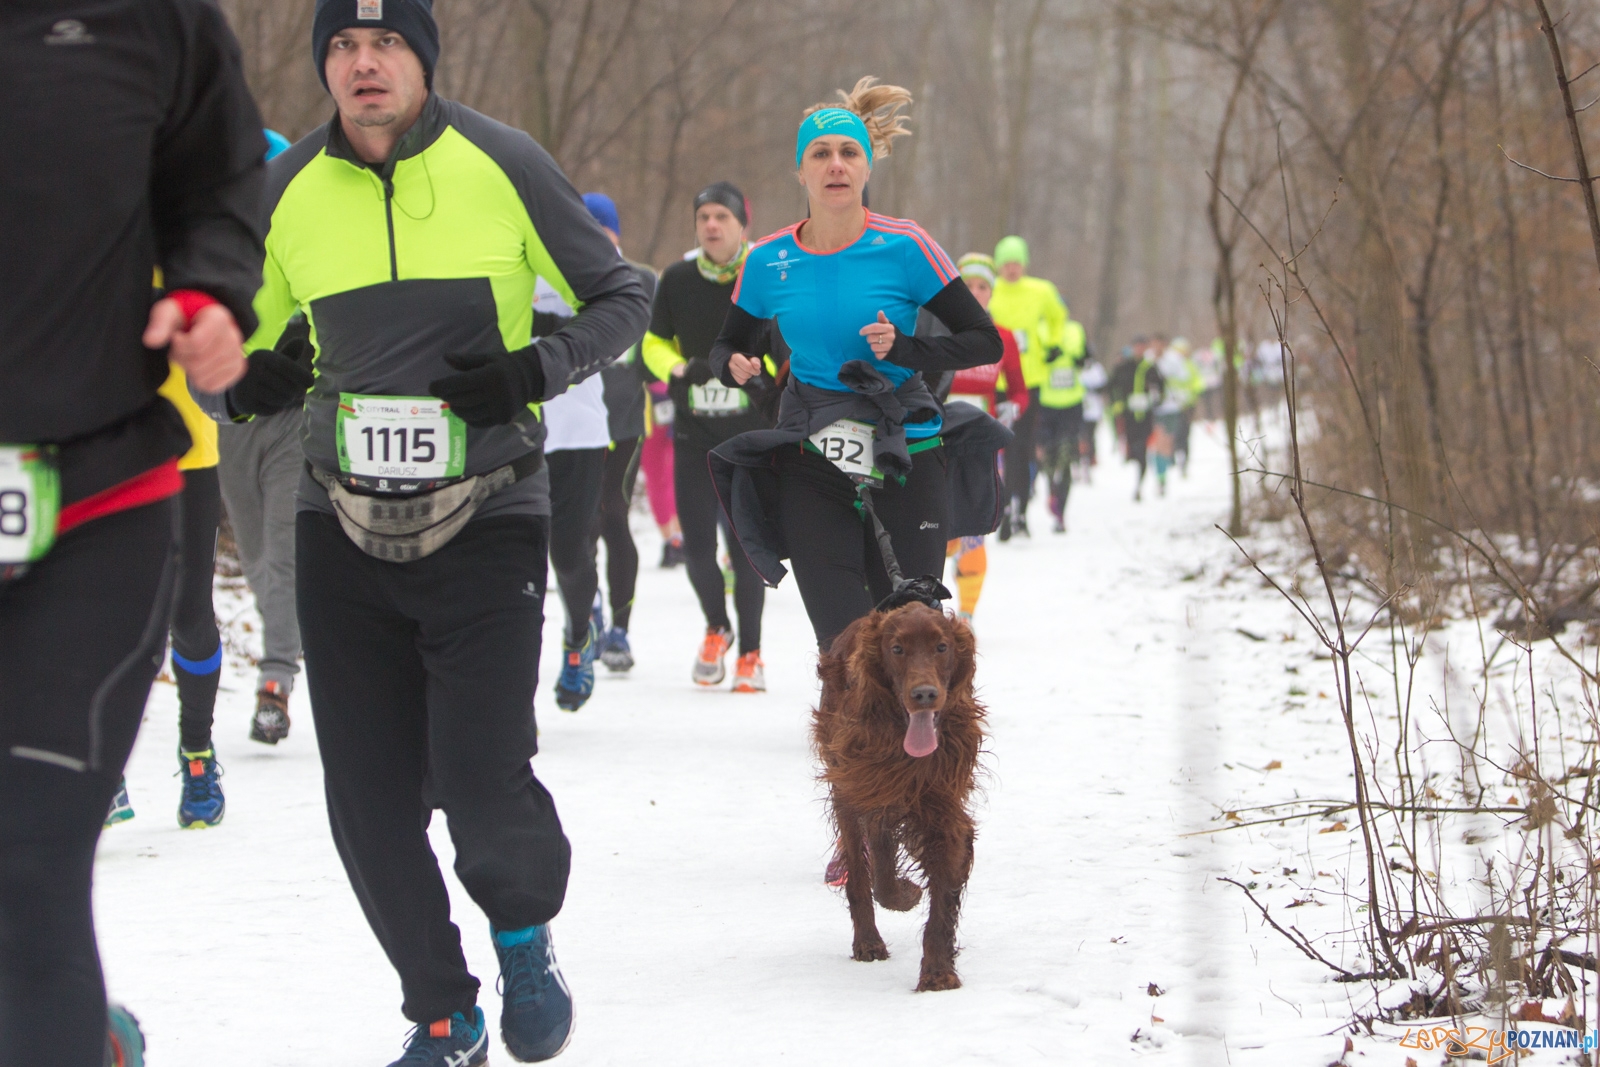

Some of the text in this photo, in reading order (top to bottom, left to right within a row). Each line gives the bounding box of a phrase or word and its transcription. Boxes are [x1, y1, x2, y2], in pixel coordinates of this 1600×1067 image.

[702, 387, 729, 402] 177
[361, 426, 436, 463] 1115
[819, 436, 864, 465] 132
[378, 466, 418, 477] DARIUSZ
[0, 490, 27, 536] 8
